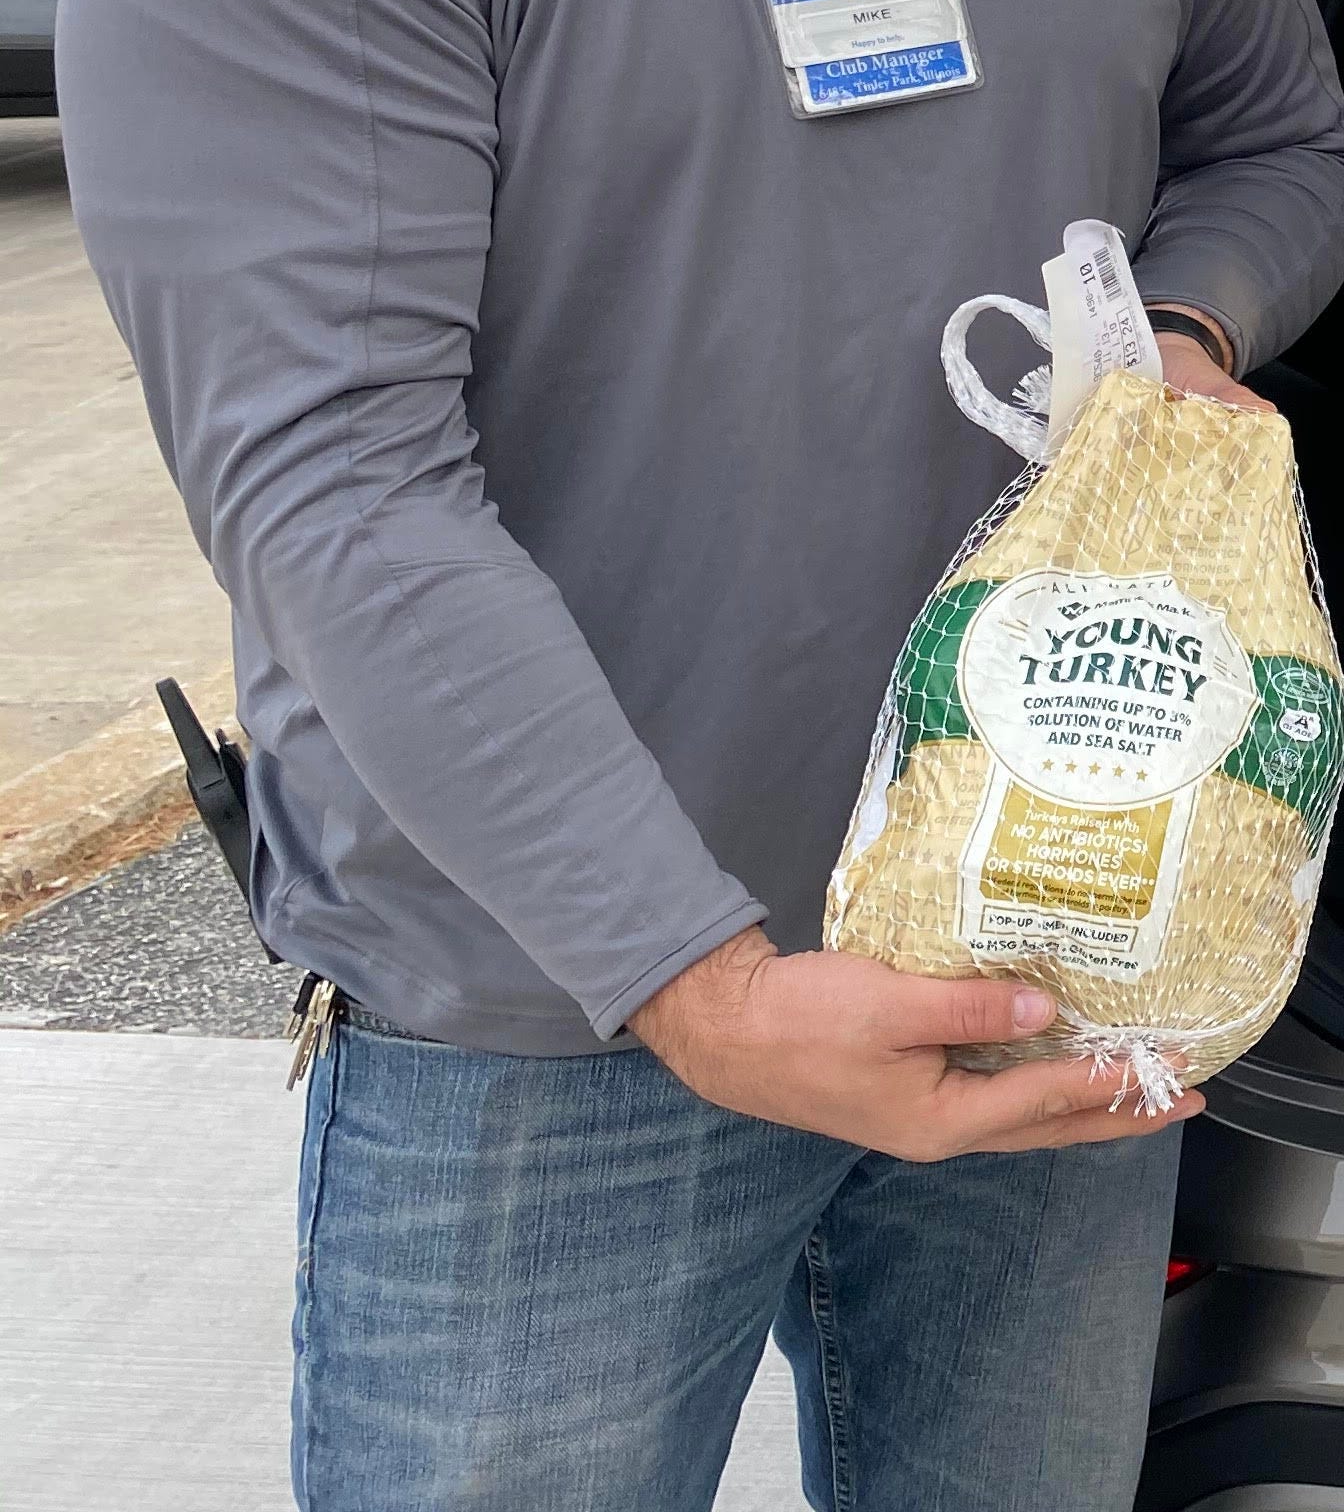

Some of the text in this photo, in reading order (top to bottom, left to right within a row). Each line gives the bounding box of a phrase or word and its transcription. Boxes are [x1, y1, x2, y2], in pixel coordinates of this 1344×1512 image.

[853, 9, 892, 24] MIKE
[851, 36, 886, 50] Happy to
[826, 48, 944, 79] Club Manager
[854, 79, 890, 94] Tinley
[922, 66, 961, 84] Illinois
[1044, 618, 1203, 665] YOUNG
[1018, 652, 1208, 703] TURKEY
[1023, 694, 1193, 727] CONTAINING UP TO 3%
[1027, 713, 1183, 743] SOLUTION OF WATER
[1047, 731, 1156, 757] AND SEA SALT
[1011, 823, 1036, 840] NO
[1025, 809, 1140, 834] Turkeys Raised With
[1026, 843, 1122, 870] HORMONES
[985, 857, 1011, 872] OR
[1012, 858, 1096, 885] STEROIDS
[987, 939, 1017, 953] MSG
